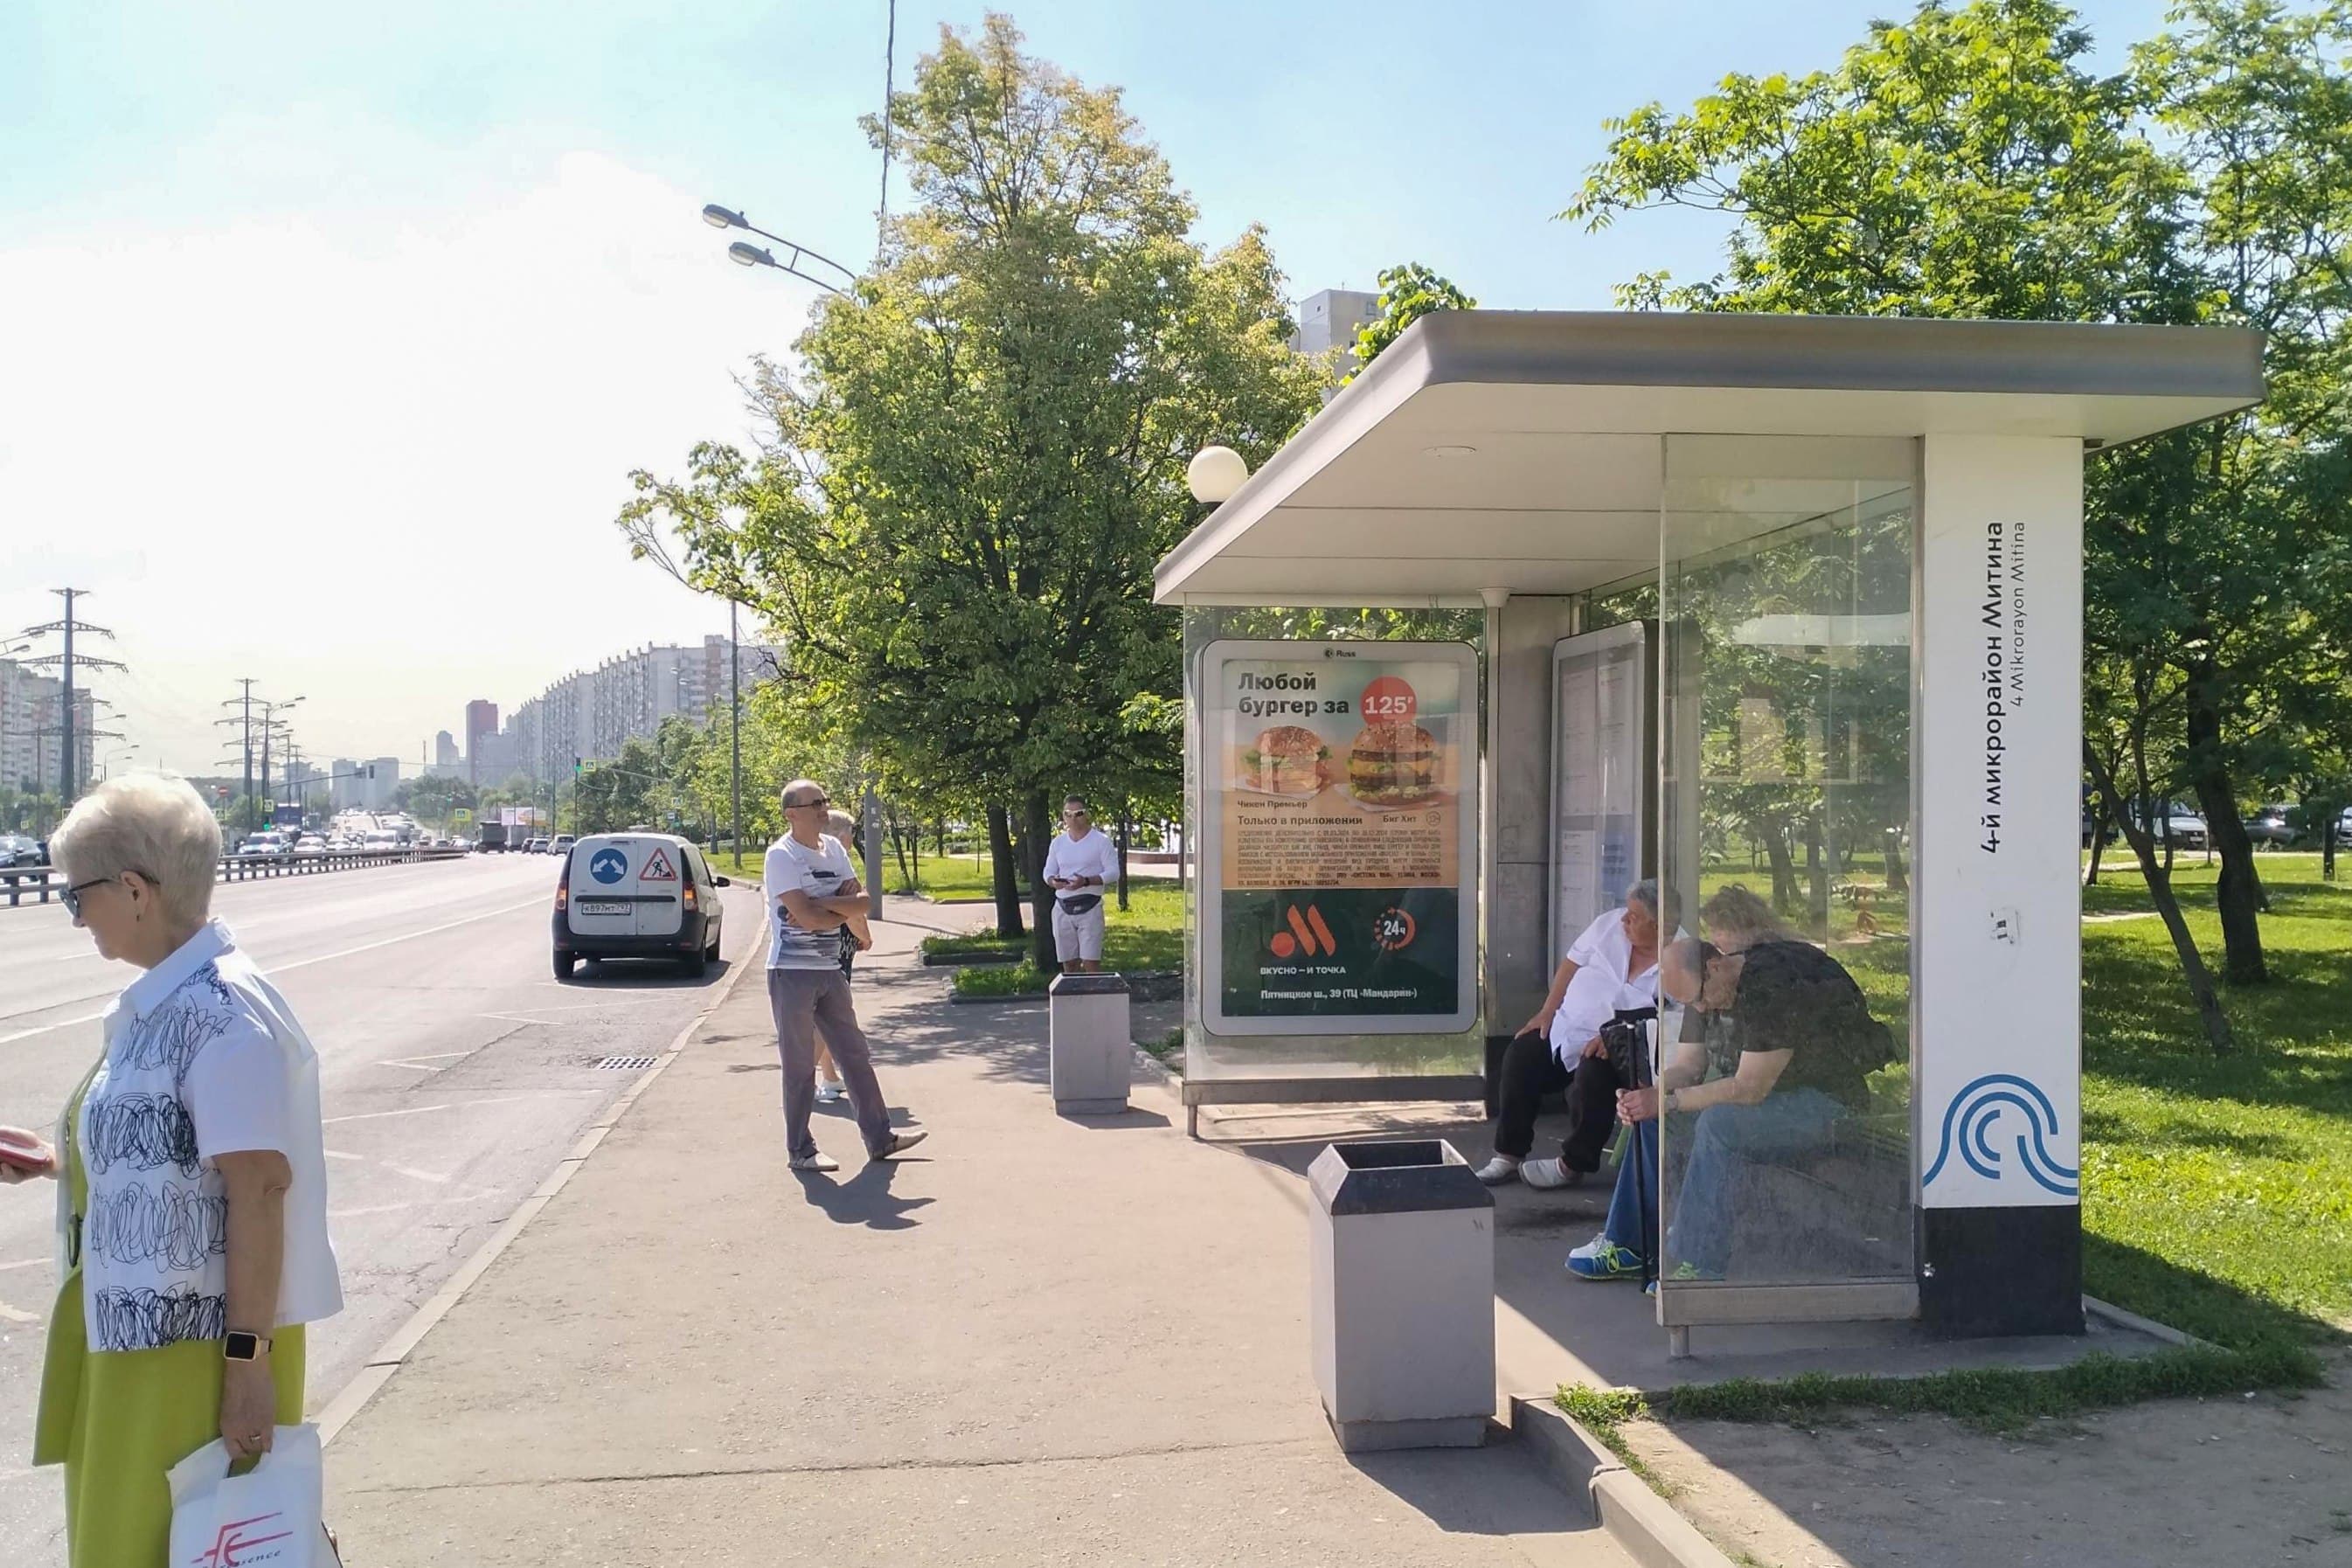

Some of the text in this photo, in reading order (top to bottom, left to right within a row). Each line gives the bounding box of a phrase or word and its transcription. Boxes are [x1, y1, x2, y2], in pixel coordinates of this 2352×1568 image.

[2010, 522, 2028, 707] 4 Mikrorayon Mitina
[1238, 671, 1316, 690] Любой
[1981, 522, 2006, 854] 4-й микрорайон Митина
[1238, 697, 1349, 717] бургер за
[1238, 800, 1308, 809] Чикен Премьер
[1238, 815, 1278, 826] Только
[1290, 816, 1363, 827] приложении
[1383, 814, 1398, 822] Биг
[1400, 814, 1417, 822] Хит
[1259, 967, 1297, 975] ВКУСНО
[1260, 989, 1312, 1000] Пятницкое
[1329, 989, 1342, 999] 39
